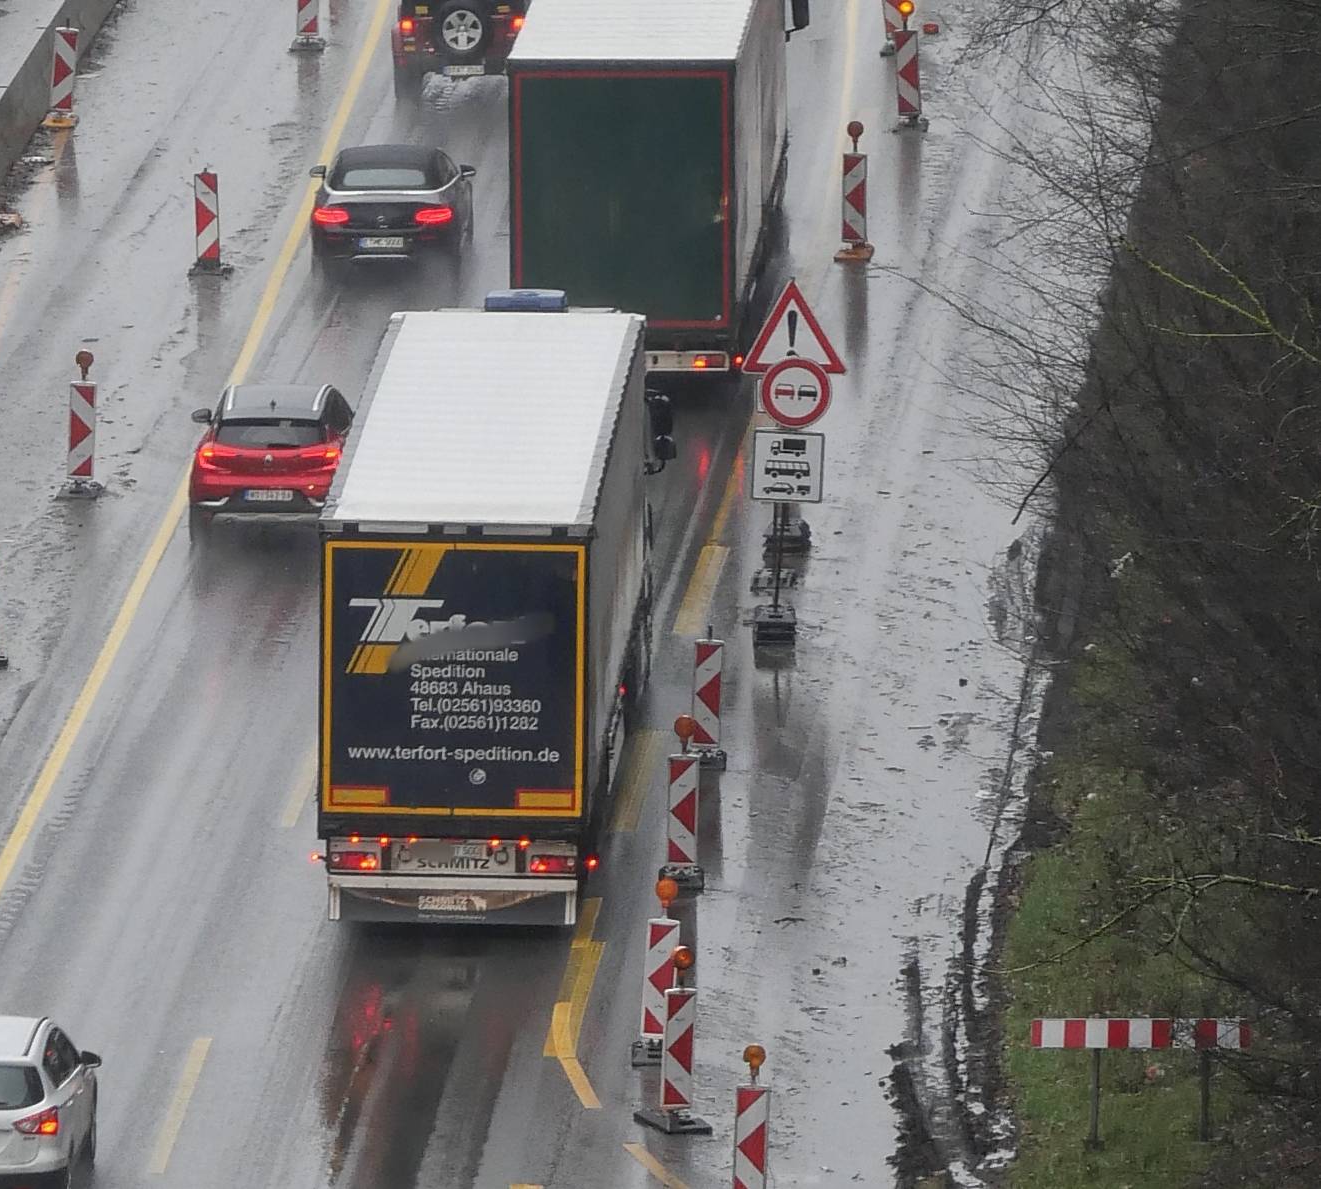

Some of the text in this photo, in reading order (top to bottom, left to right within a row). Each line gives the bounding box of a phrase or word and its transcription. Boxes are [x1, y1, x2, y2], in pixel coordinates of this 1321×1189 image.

[348, 598, 529, 645] Terf
[411, 647, 519, 661] ernationale
[410, 663, 486, 680] Spedition
[410, 681, 512, 695] 48683 Ahaus
[410, 697, 542, 715] Tel.(02561)93360
[410, 714, 539, 732] Fax.(02561)1282
[347, 745, 560, 763] www.terfort-spedition.de
